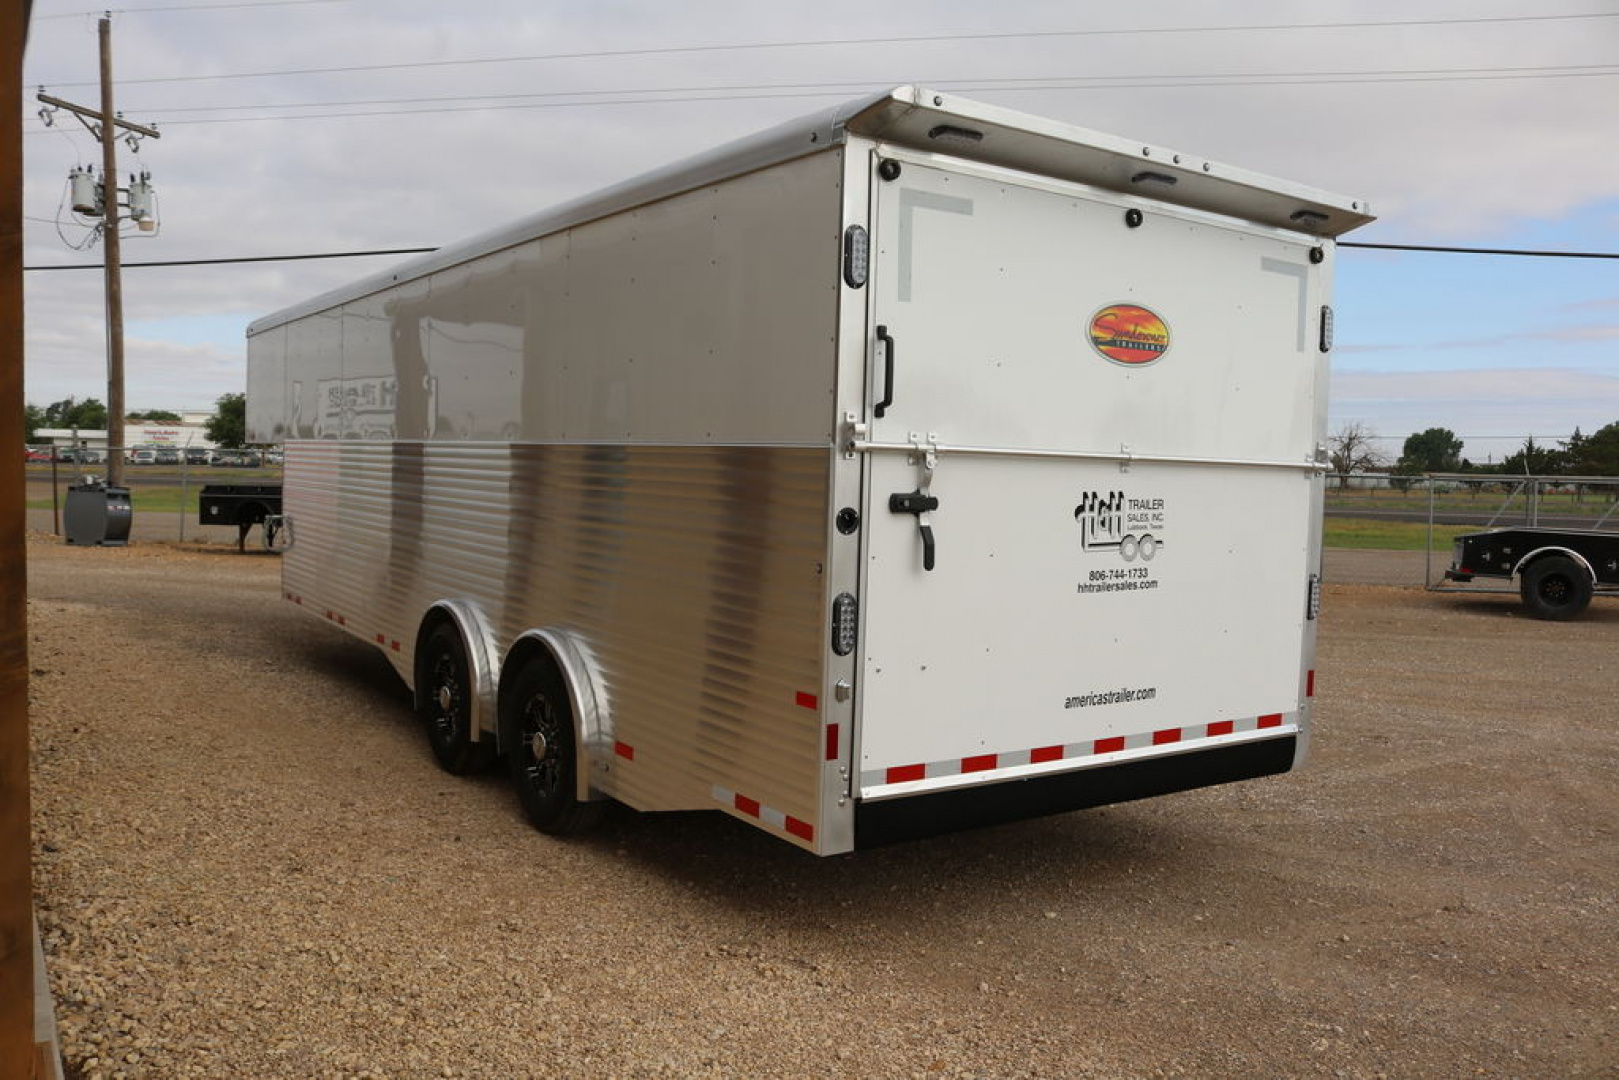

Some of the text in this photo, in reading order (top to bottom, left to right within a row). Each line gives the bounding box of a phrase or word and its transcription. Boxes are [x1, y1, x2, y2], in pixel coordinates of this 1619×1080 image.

[1128, 499, 1164, 510] TRAILER
[1088, 567, 1149, 581] 806-744-1733
[1077, 580, 1158, 593] hhtrailersales.com
[1064, 687, 1156, 709] americastrailer.com
